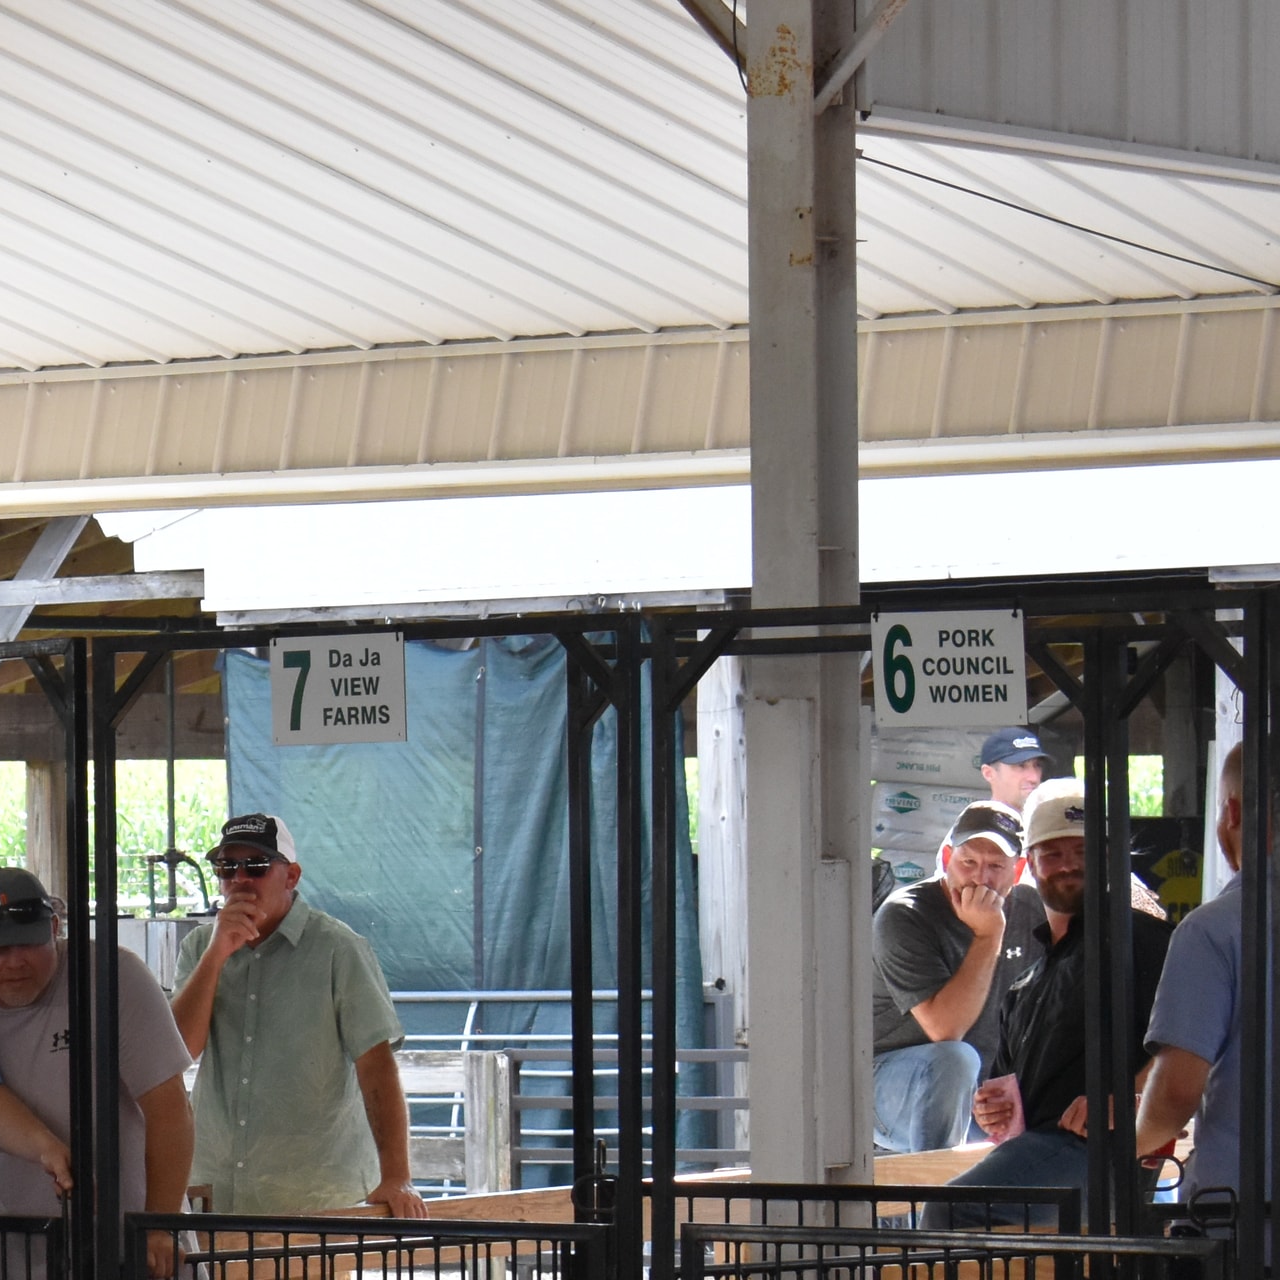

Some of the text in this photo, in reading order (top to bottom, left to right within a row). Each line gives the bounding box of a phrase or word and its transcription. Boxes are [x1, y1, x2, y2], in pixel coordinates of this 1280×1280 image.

[938, 630, 995, 648] PORK
[328, 649, 382, 668] Da Ja
[883, 623, 915, 714] 6
[922, 655, 1015, 676] COUNCIL
[283, 649, 312, 732] 7
[331, 676, 380, 697] VIEW
[929, 684, 1008, 704] WOMEN
[323, 705, 390, 727] FARMS
